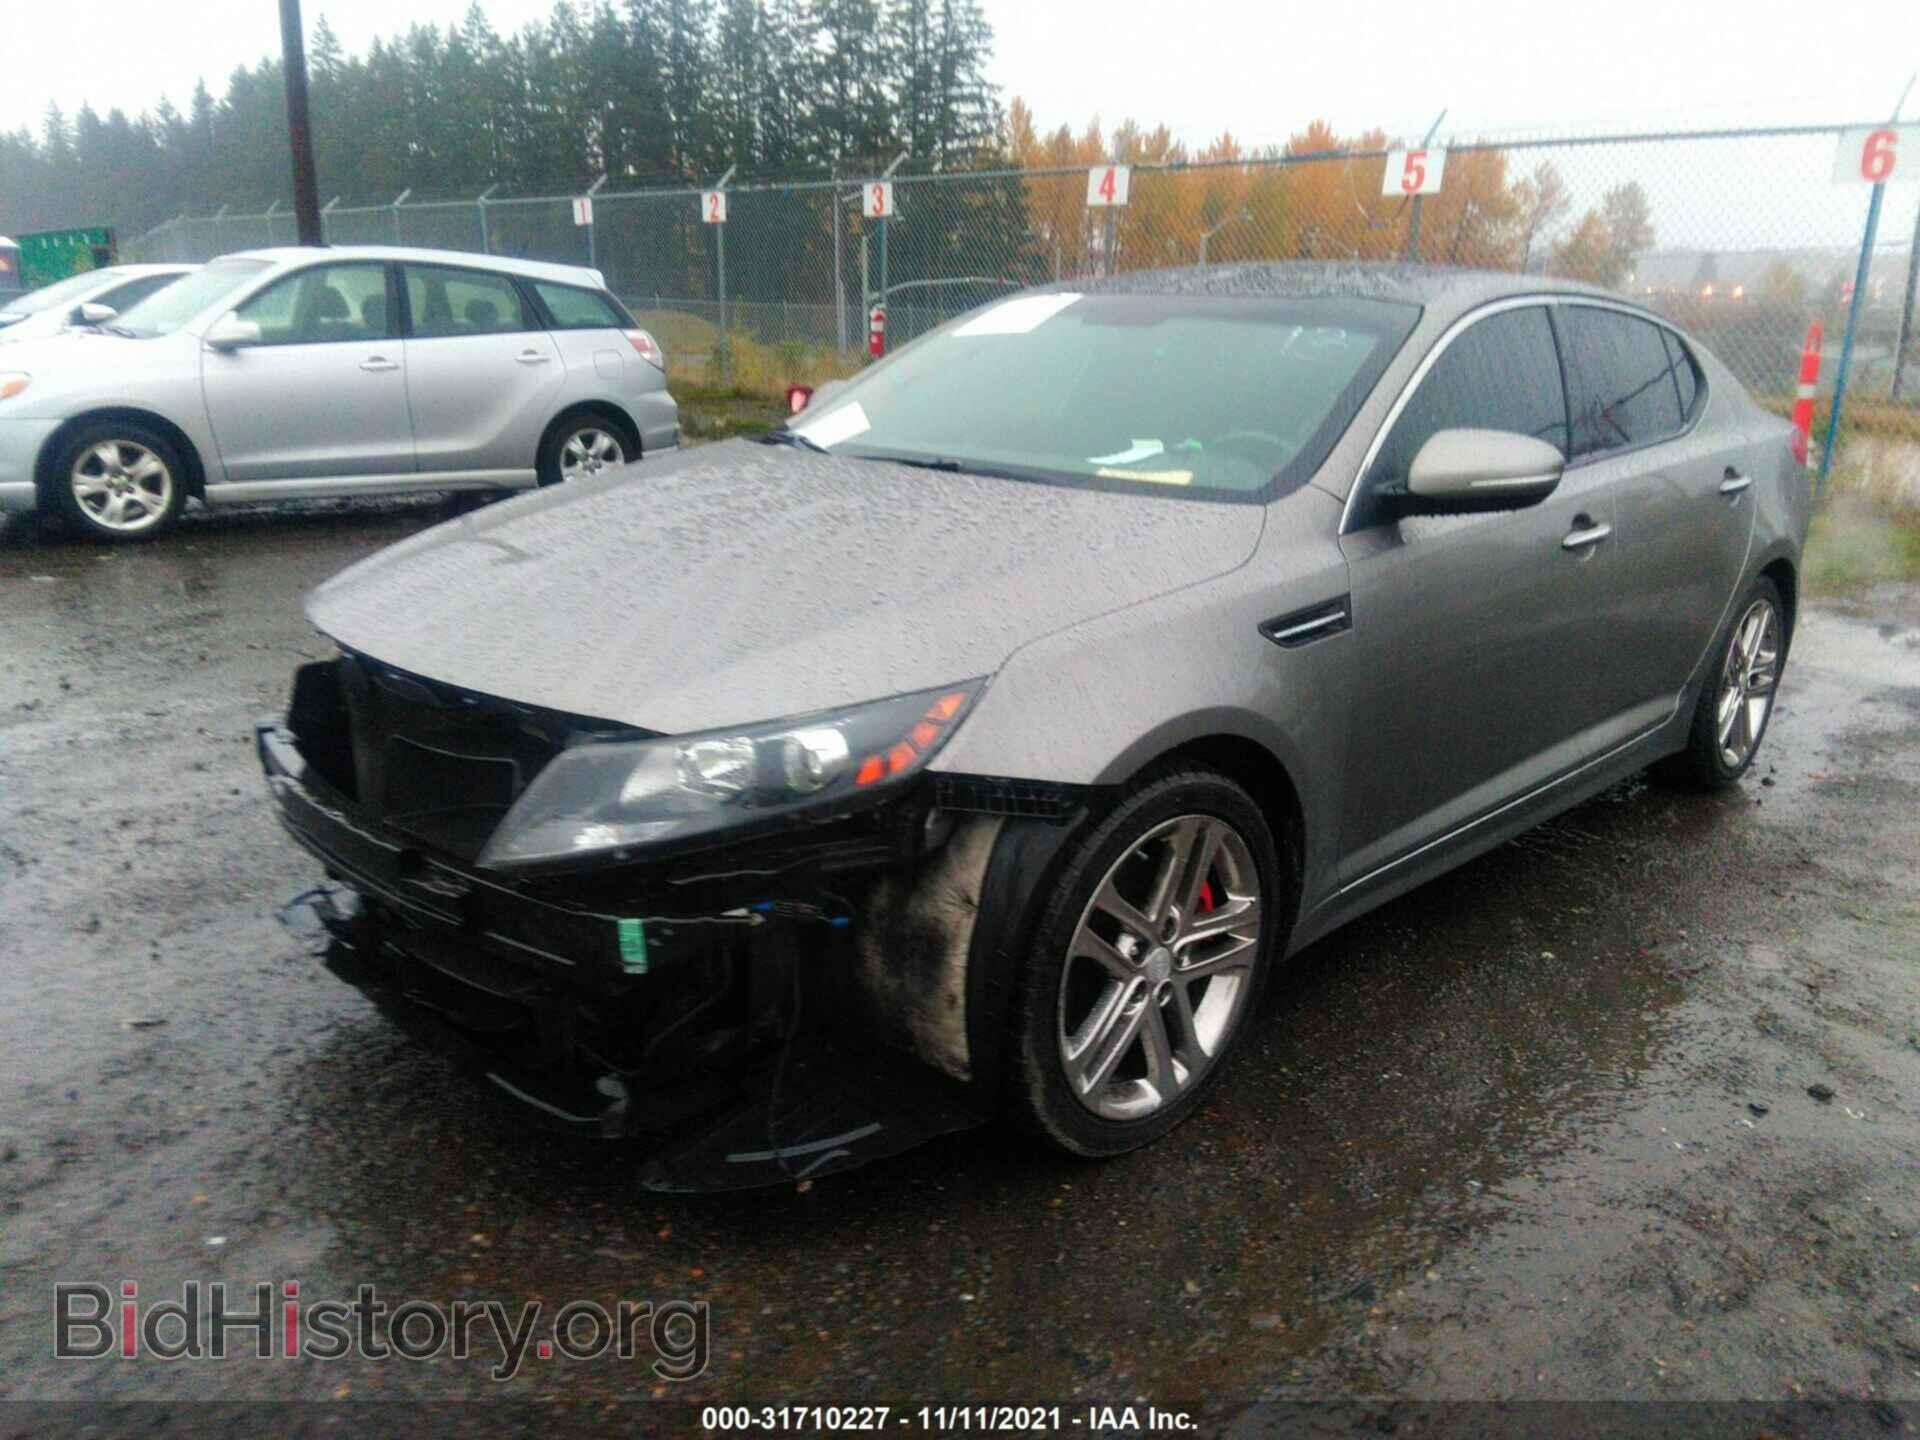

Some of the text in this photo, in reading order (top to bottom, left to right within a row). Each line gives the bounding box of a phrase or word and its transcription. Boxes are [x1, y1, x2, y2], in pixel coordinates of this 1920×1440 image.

[1401, 150, 1428, 194] 5
[1859, 128, 1898, 183] 6
[872, 183, 885, 216] 3
[1098, 167, 1117, 204] 4
[709, 192, 720, 222] 2
